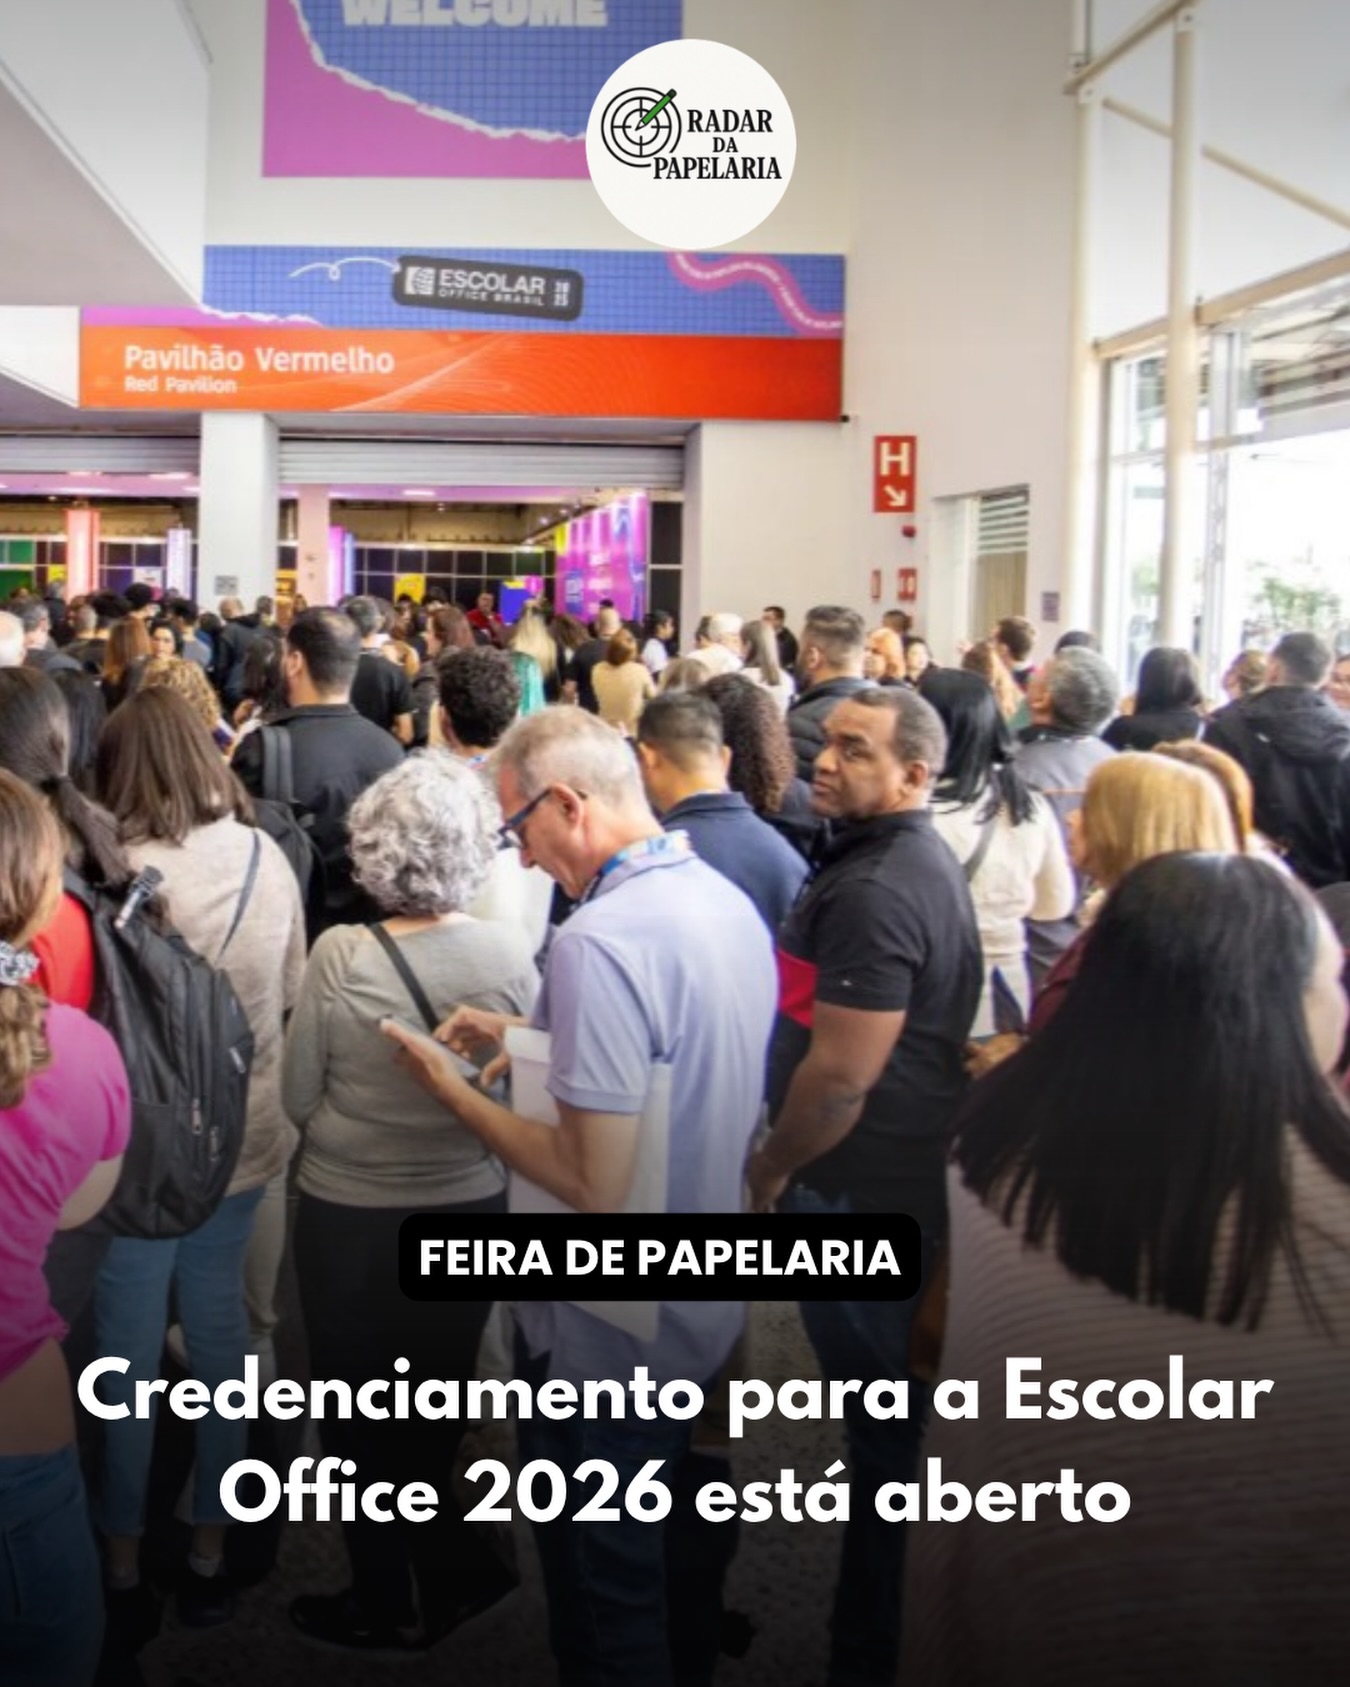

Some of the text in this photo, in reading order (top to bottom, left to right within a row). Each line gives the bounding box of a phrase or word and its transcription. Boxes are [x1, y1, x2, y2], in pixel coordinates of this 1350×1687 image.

[439, 268, 546, 295] ESCOLAR
[124, 343, 395, 374] Pavilhão Vermelho
[124, 375, 238, 394] Red Pavilion
[880, 442, 911, 476] H
